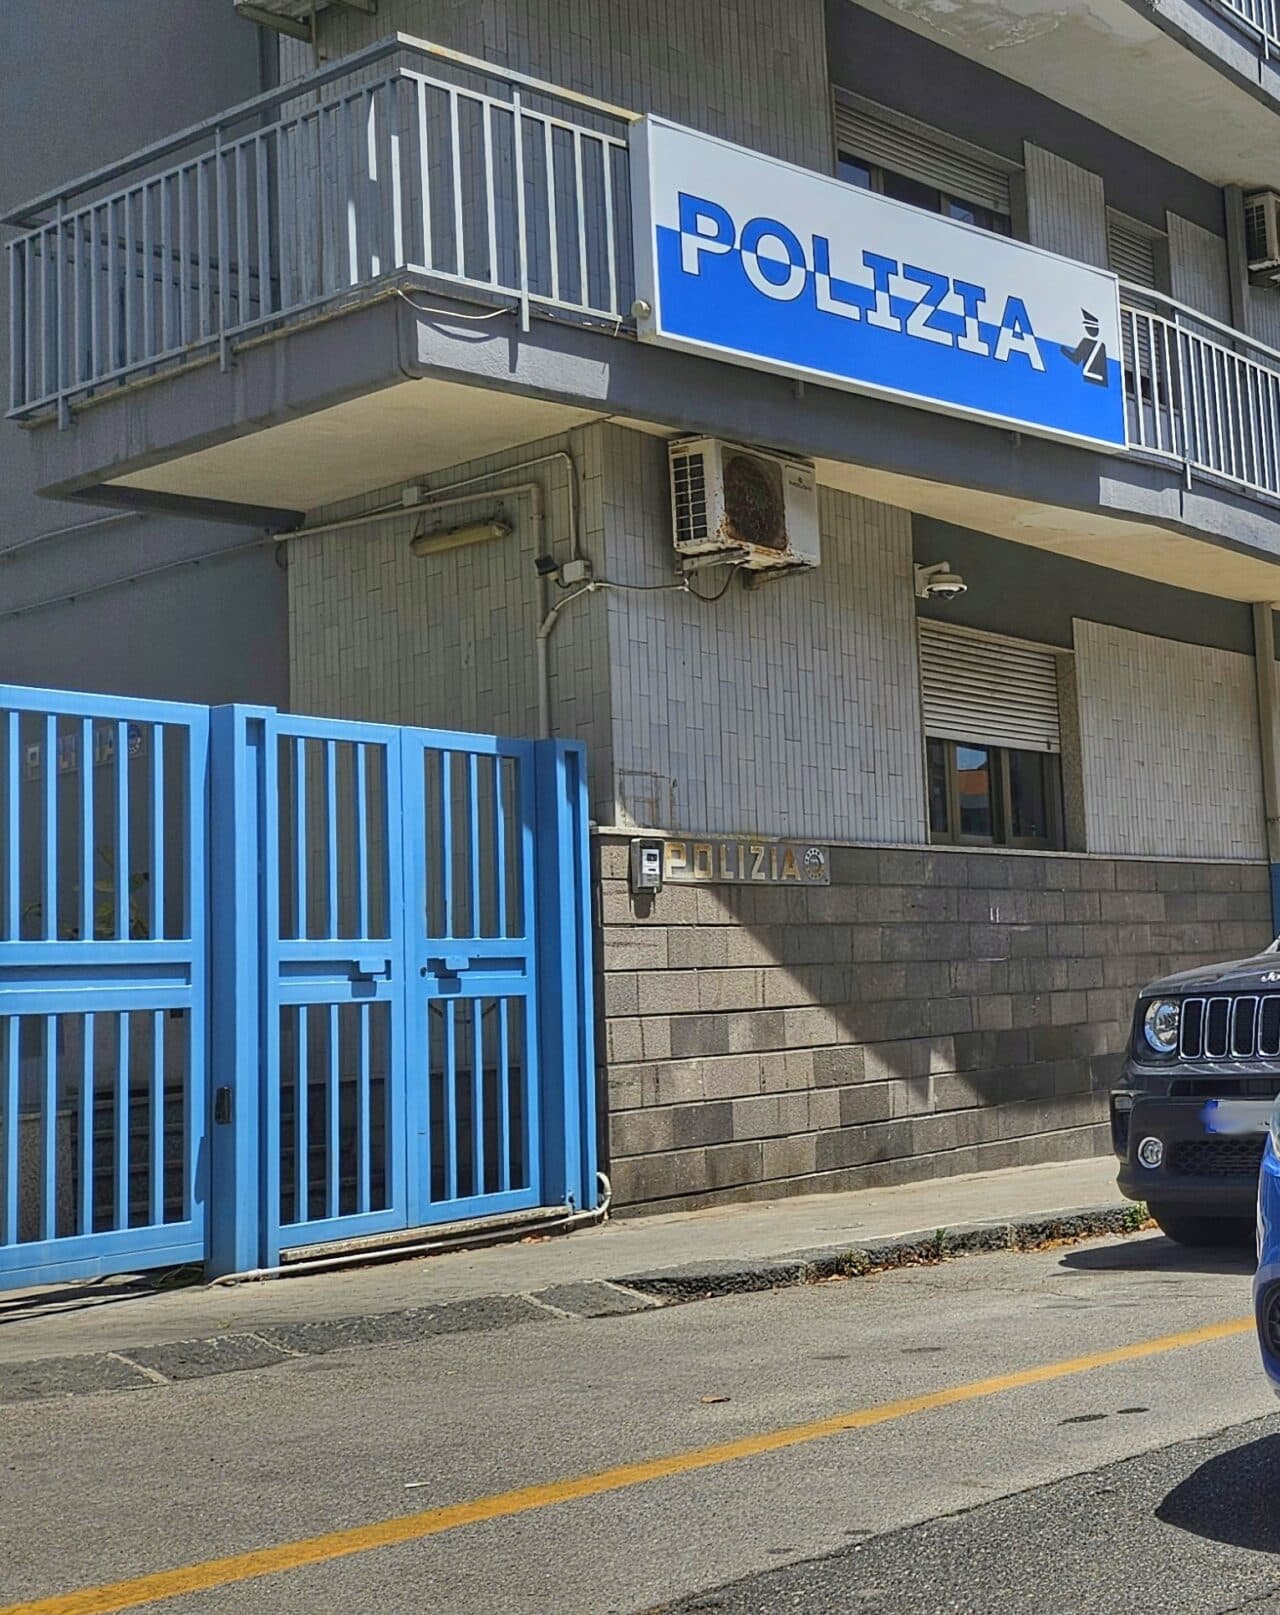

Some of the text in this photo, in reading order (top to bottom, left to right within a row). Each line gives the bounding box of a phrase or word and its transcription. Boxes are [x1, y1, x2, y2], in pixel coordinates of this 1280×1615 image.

[678, 191, 1045, 372] POLIZIA
[25, 726, 117, 779] PLIIA
[665, 842, 801, 881] POLIZIA
